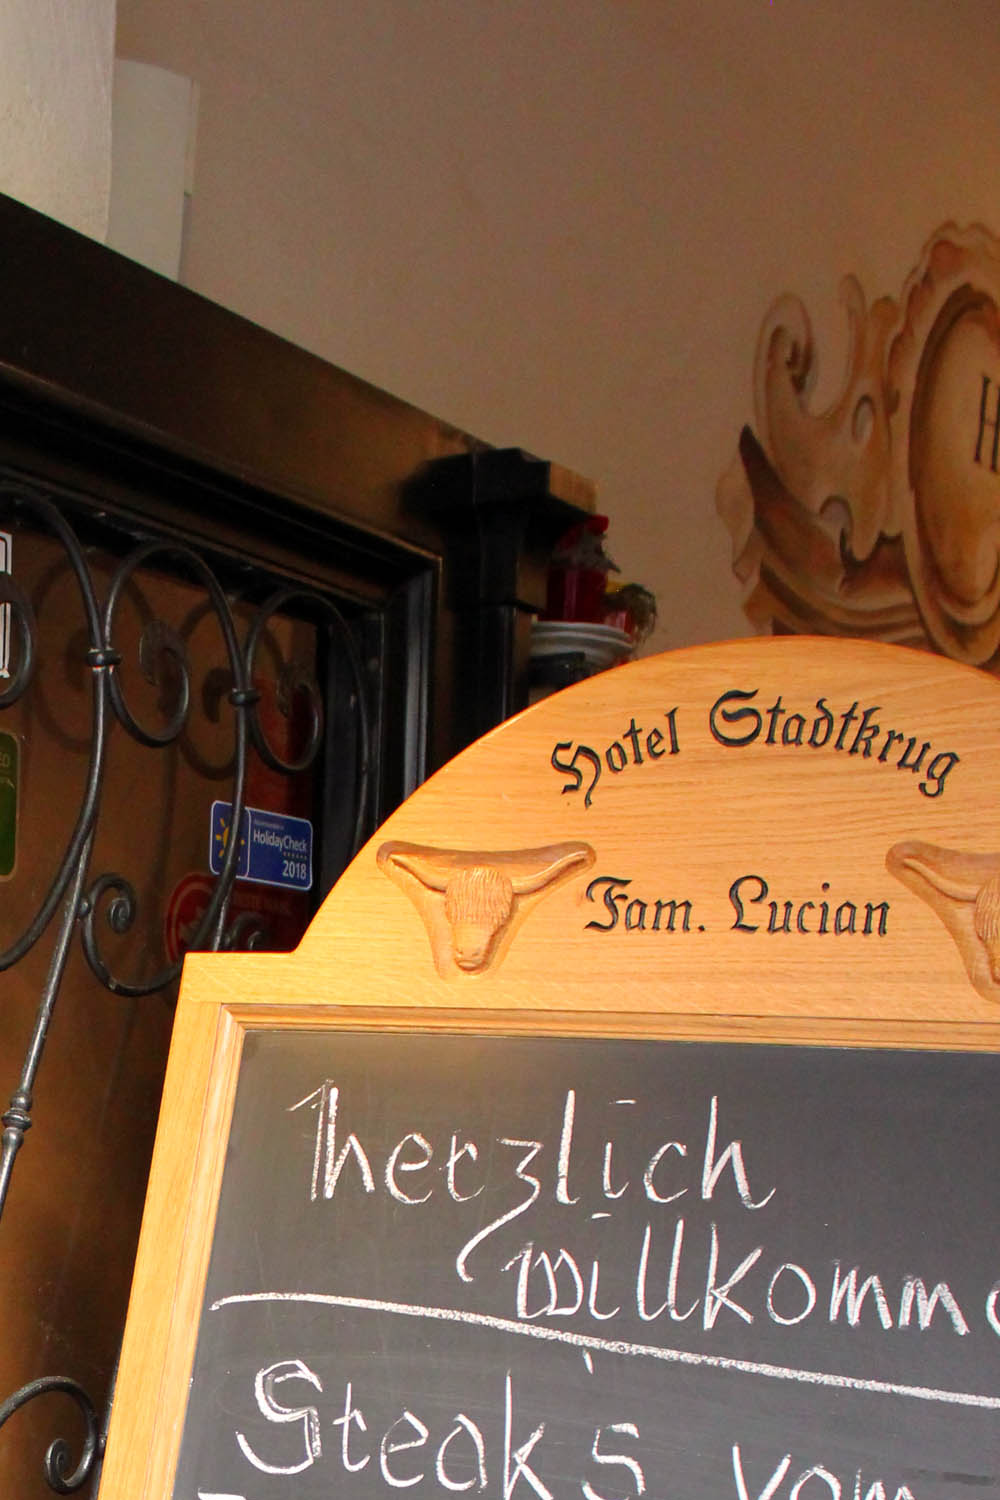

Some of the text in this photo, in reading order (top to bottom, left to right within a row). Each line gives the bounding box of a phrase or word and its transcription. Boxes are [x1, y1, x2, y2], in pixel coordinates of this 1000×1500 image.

[551, 688, 961, 809] Hotel Stadtkrug
[253, 829, 307, 852] HolidayCheck
[282, 860, 307, 880] 2018
[584, 875, 891, 937] Fam. Lucian
